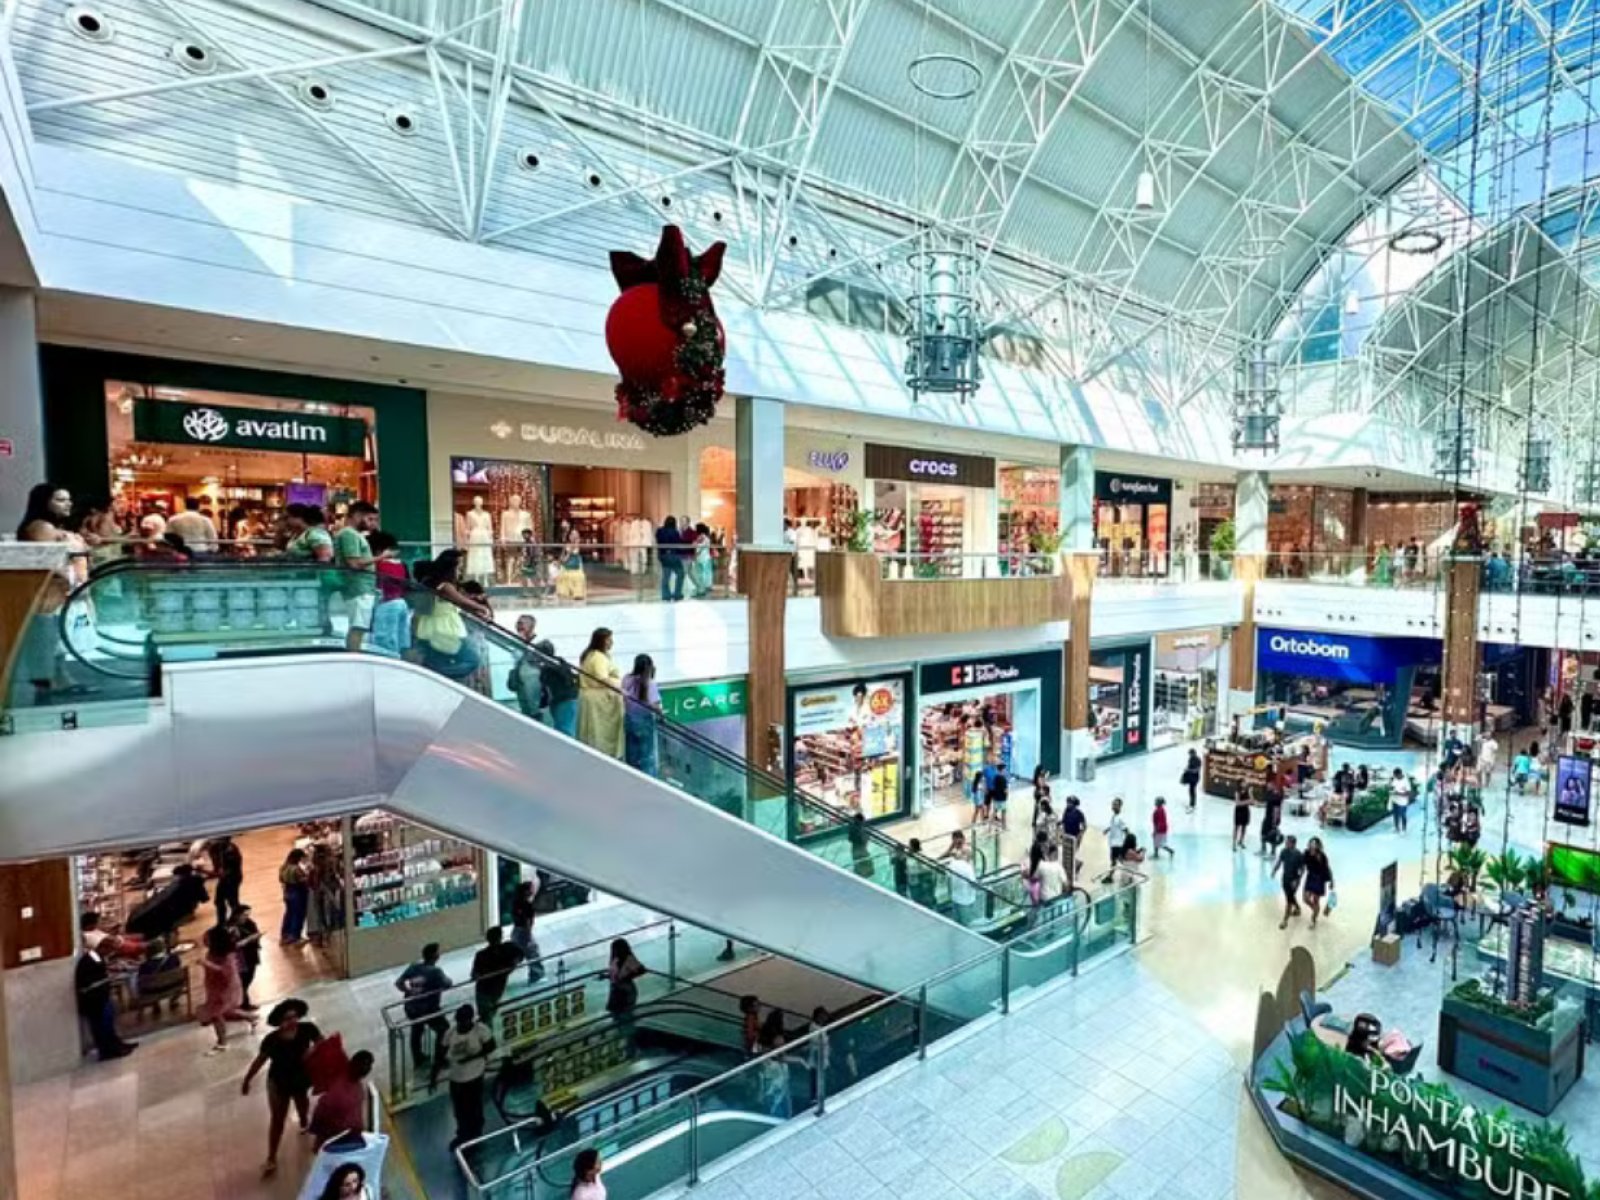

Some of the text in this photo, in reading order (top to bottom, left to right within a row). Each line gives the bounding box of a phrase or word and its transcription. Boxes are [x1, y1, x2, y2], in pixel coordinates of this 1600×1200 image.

[235, 416, 327, 443] avatim
[520, 422, 645, 450] DUDALINA
[908, 458, 958, 476] crocs
[1269, 635, 1350, 660] Ortobom
[682, 691, 741, 711] CARE
[1369, 1069, 1480, 1143] PONTA
[1486, 1113, 1525, 1160] DE
